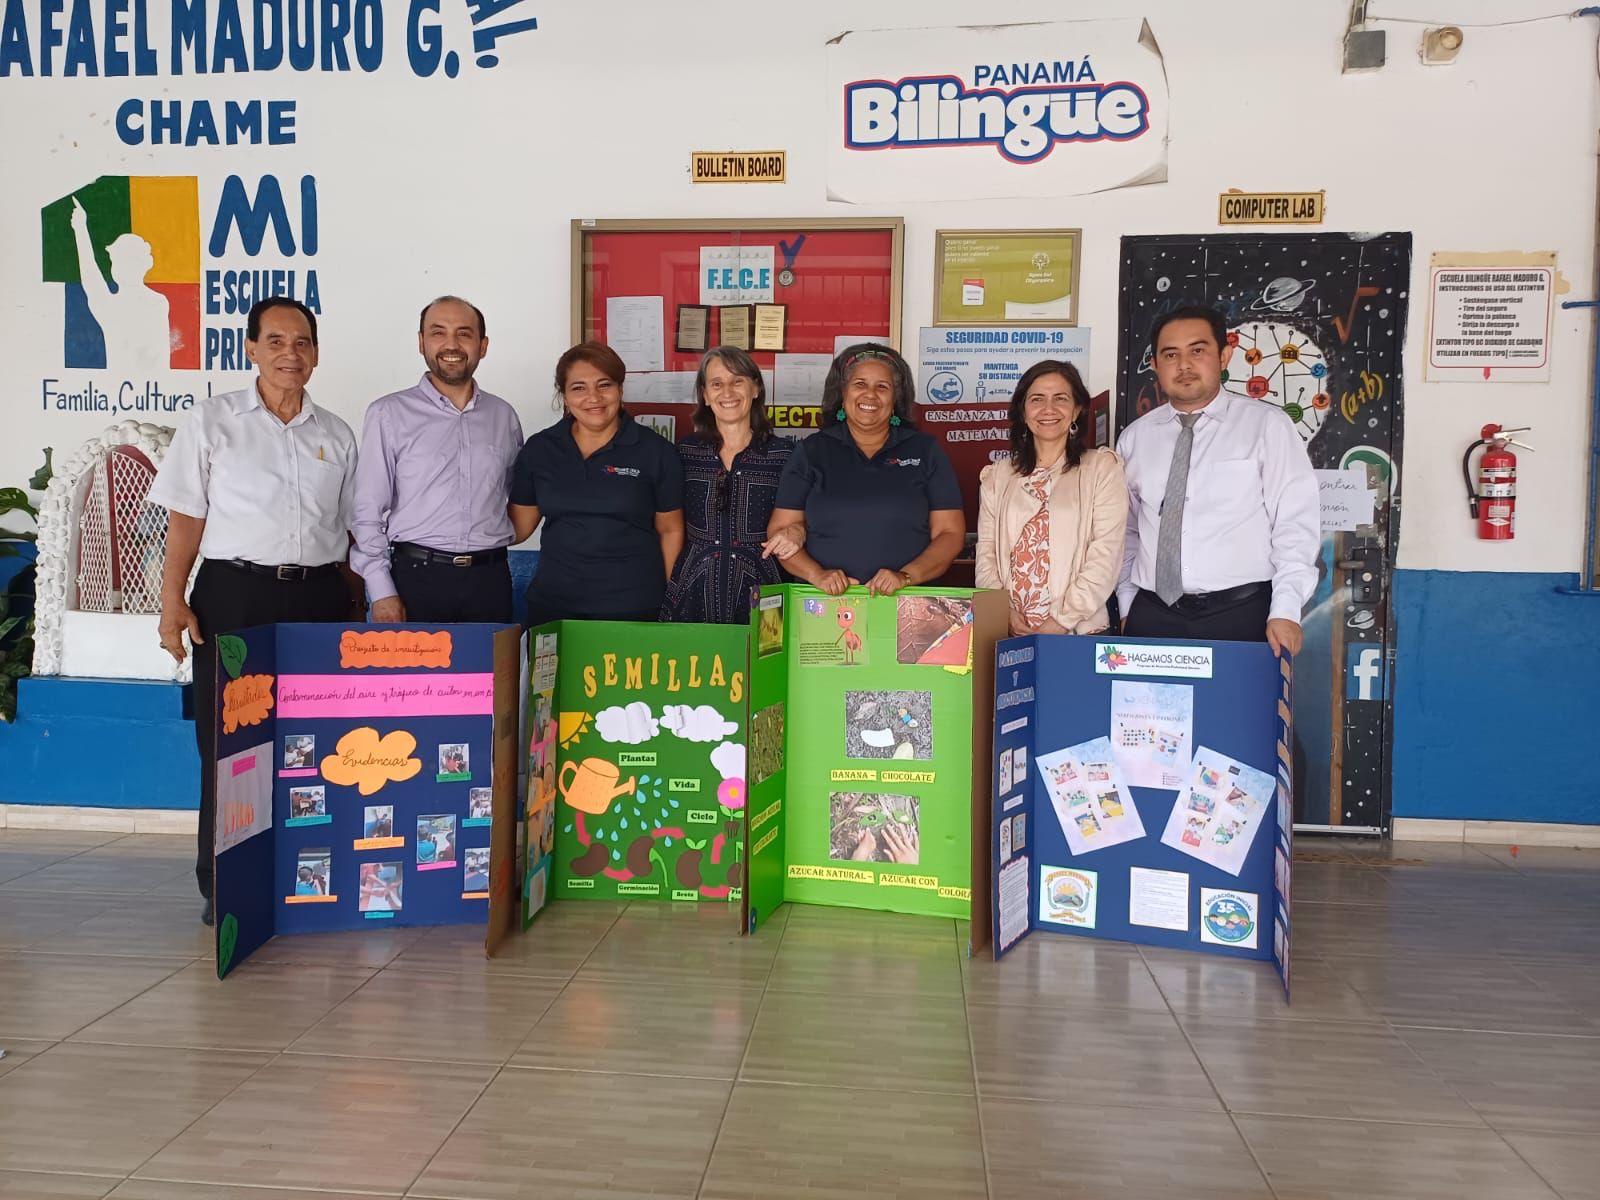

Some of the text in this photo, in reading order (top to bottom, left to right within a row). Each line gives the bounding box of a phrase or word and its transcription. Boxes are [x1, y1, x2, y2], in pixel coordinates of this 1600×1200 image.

[171, 0, 384, 74] MADURO
[407, 0, 460, 79] G.
[974, 55, 1096, 87] PANAMÁ
[115, 98, 297, 146] CHAME
[697, 157, 782, 177] BULLETIN BOARD
[209, 174, 318, 257] MI
[1225, 198, 1316, 219] COMPUTER LAB
[707, 268, 770, 290] F.E.C.E
[1440, 274, 1464, 282] ESCUELA
[1492, 274, 1511, 282] RAFAEL
[1513, 274, 1537, 282] MADURO
[945, 331, 1064, 344] SEGURIDAD COVID-19
[984, 363, 1018, 371] MANTENGA
[118, 381, 195, 413] Cultura
[927, 409, 995, 421] ENSEÑANZA
[1127, 653, 1210, 665] HAGAMOS CIENCIA
[583, 653, 743, 703] SEMILLAS
[342, 687, 355, 700] del
[358, 690, 376, 699] aire
[422, 684, 433, 696] de
[342, 748, 408, 767] Evidencias
[620, 754, 655, 763] Plantas
[674, 781, 696, 789] Vida
[832, 771, 868, 779] BANANA
[882, 772, 932, 782] CHOCOLATE
[690, 812, 714, 821] Ciclo
[789, 867, 824, 877] AZUCAR
[826, 870, 866, 880] NATURAL
[880, 874, 917, 885] AZUCAR
[918, 877, 936, 887] CON
[1217, 901, 1236, 914] 35
